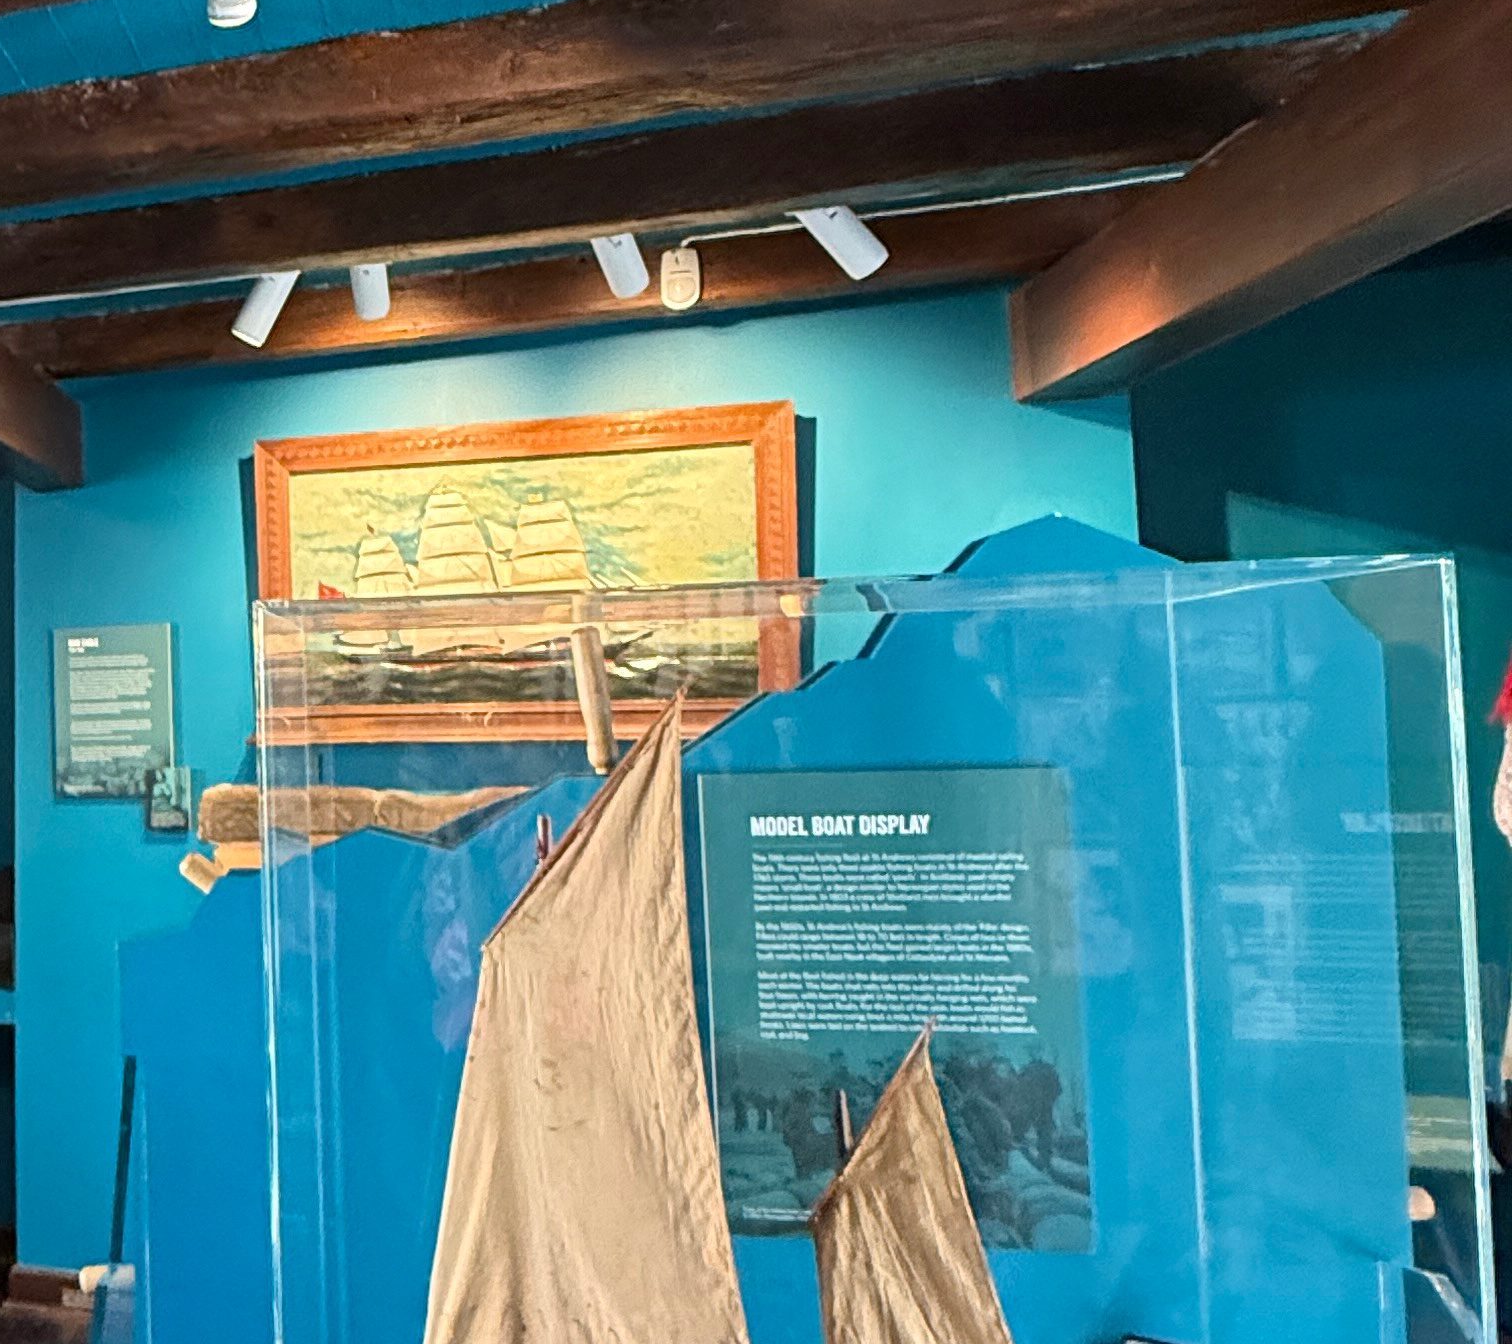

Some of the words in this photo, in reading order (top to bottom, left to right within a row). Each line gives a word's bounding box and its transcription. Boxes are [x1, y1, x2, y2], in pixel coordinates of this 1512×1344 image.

[749, 815, 809, 837] MODEL
[811, 814, 856, 837] BOAT
[858, 812, 931, 836] DISPLAY
